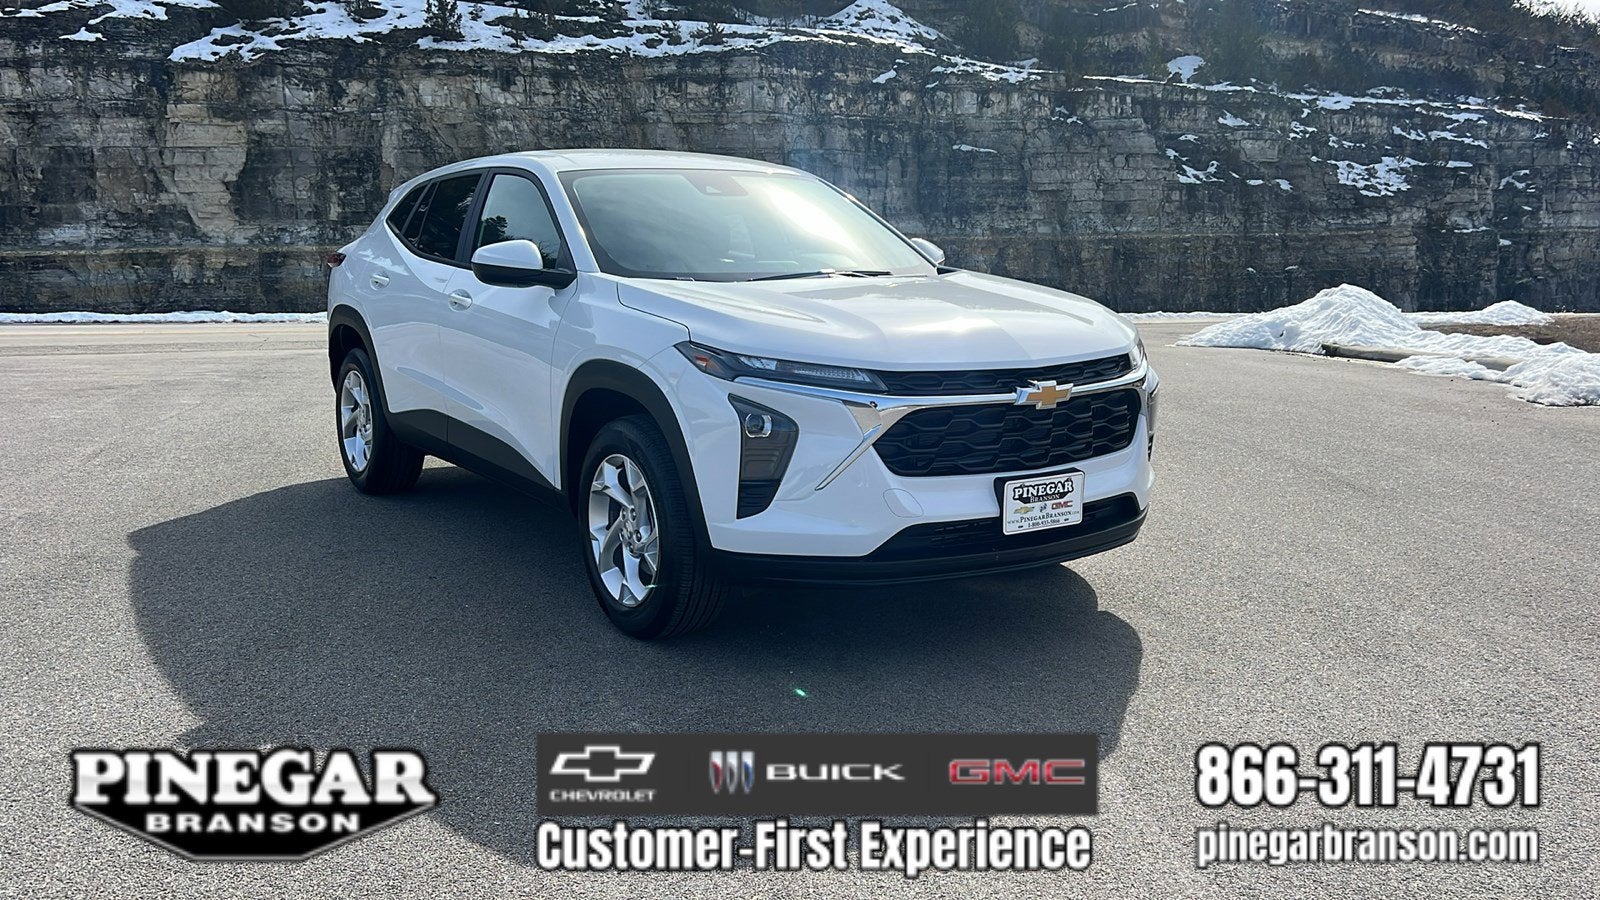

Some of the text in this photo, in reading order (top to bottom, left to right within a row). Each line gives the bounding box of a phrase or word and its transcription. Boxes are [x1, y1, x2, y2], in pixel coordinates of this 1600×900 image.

[1014, 481, 1073, 499] PINEGAR
[1030, 493, 1061, 503] BRANSON
[1051, 500, 1073, 510] GMC
